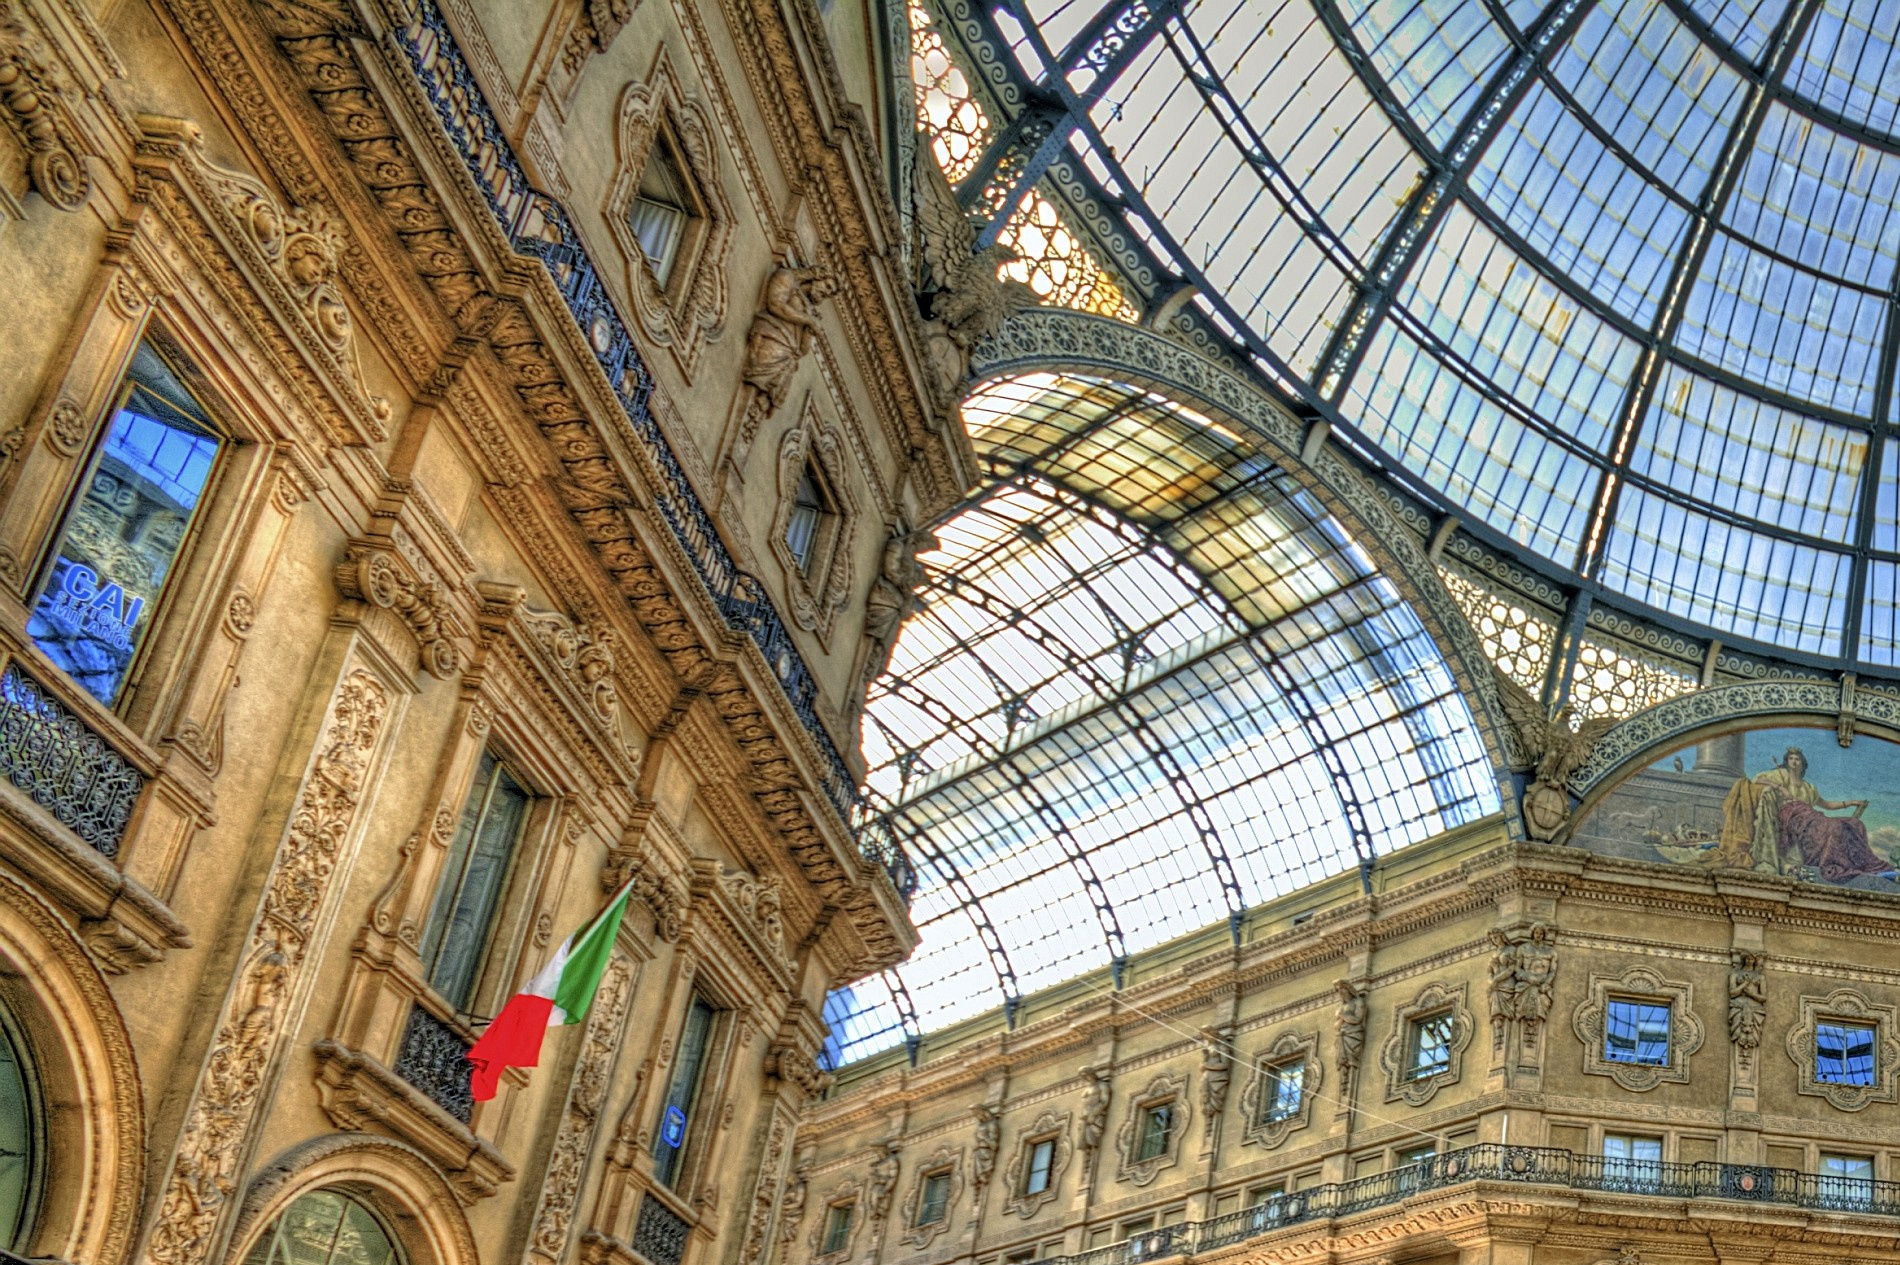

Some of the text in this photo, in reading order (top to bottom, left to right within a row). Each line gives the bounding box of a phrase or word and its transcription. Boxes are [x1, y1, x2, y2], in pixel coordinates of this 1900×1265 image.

[54, 590, 133, 637] SEZIONE
[63, 563, 145, 628] CAI
[50, 601, 129, 650] MILANO
